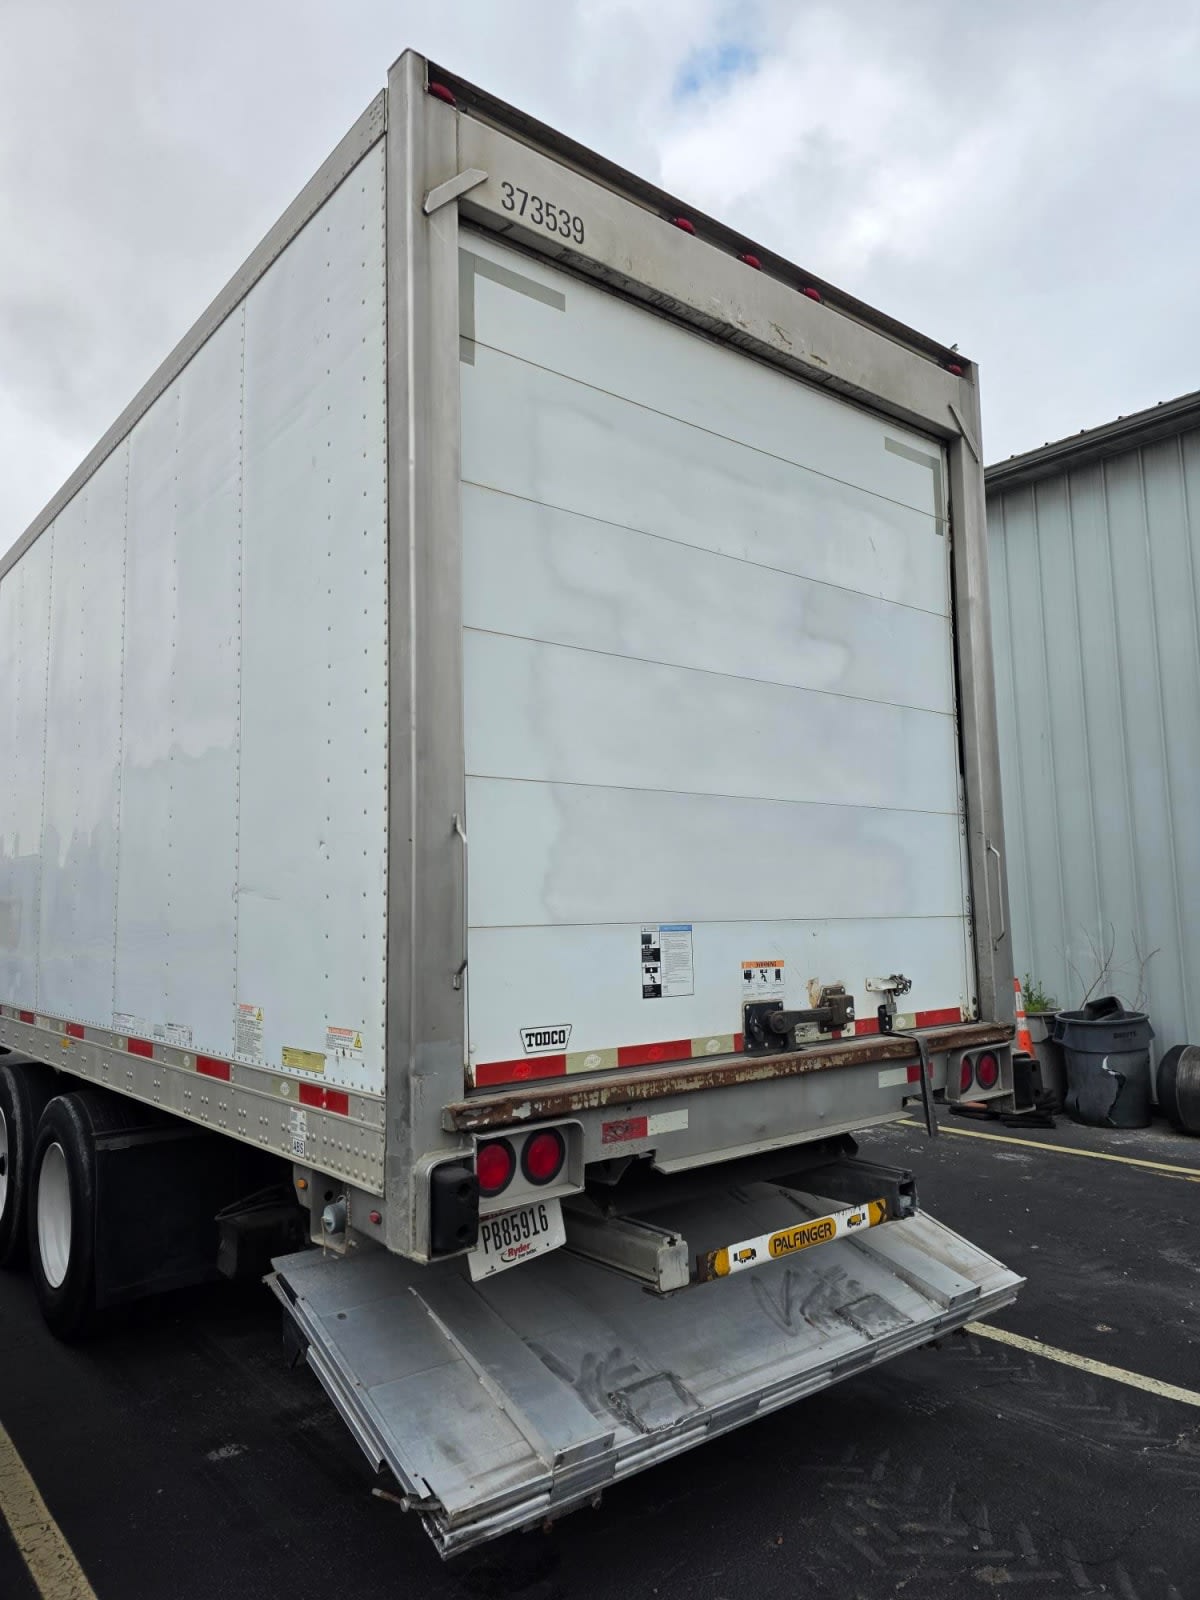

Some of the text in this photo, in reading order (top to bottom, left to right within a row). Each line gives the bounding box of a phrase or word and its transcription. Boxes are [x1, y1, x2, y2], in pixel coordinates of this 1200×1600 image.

[501, 181, 584, 244] 373539
[525, 1029, 566, 1047] TODCO
[293, 1140, 304, 1154] ABS
[481, 1204, 549, 1254] PB85916
[773, 1222, 832, 1254] PALFINGER
[507, 1243, 531, 1257] Ryder
